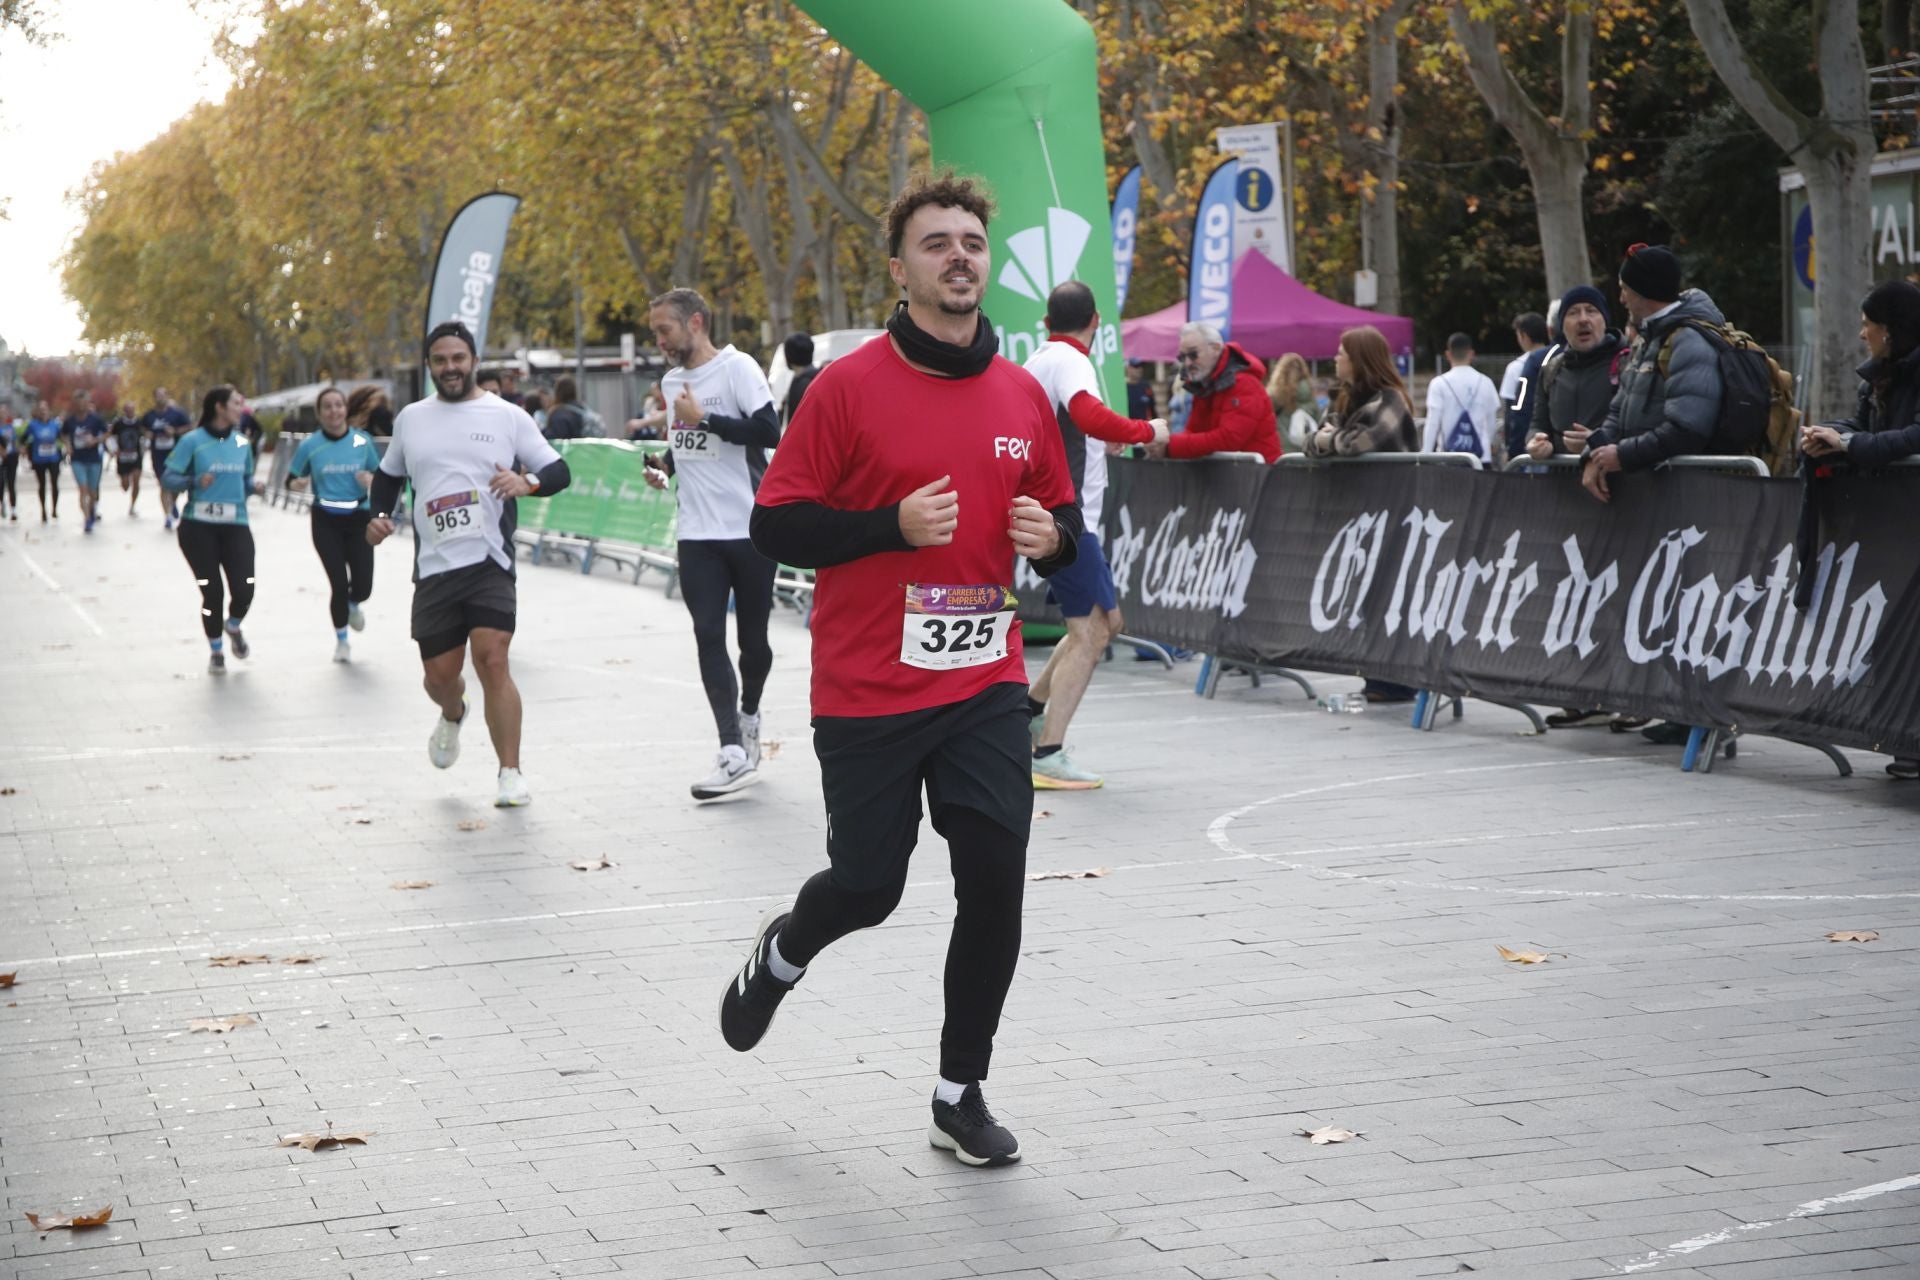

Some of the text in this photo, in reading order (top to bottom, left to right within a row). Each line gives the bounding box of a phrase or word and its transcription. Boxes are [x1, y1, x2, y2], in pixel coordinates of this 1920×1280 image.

[451, 250, 495, 335] icaja
[674, 431, 707, 451] 962
[435, 507, 471, 533] 963
[946, 596, 987, 606] EMPRESAS
[947, 588, 977, 597] CARRERA
[977, 587, 986, 596] DE
[1309, 505, 1888, 690] El Norte de Castilla
[920, 616, 997, 653] 325
